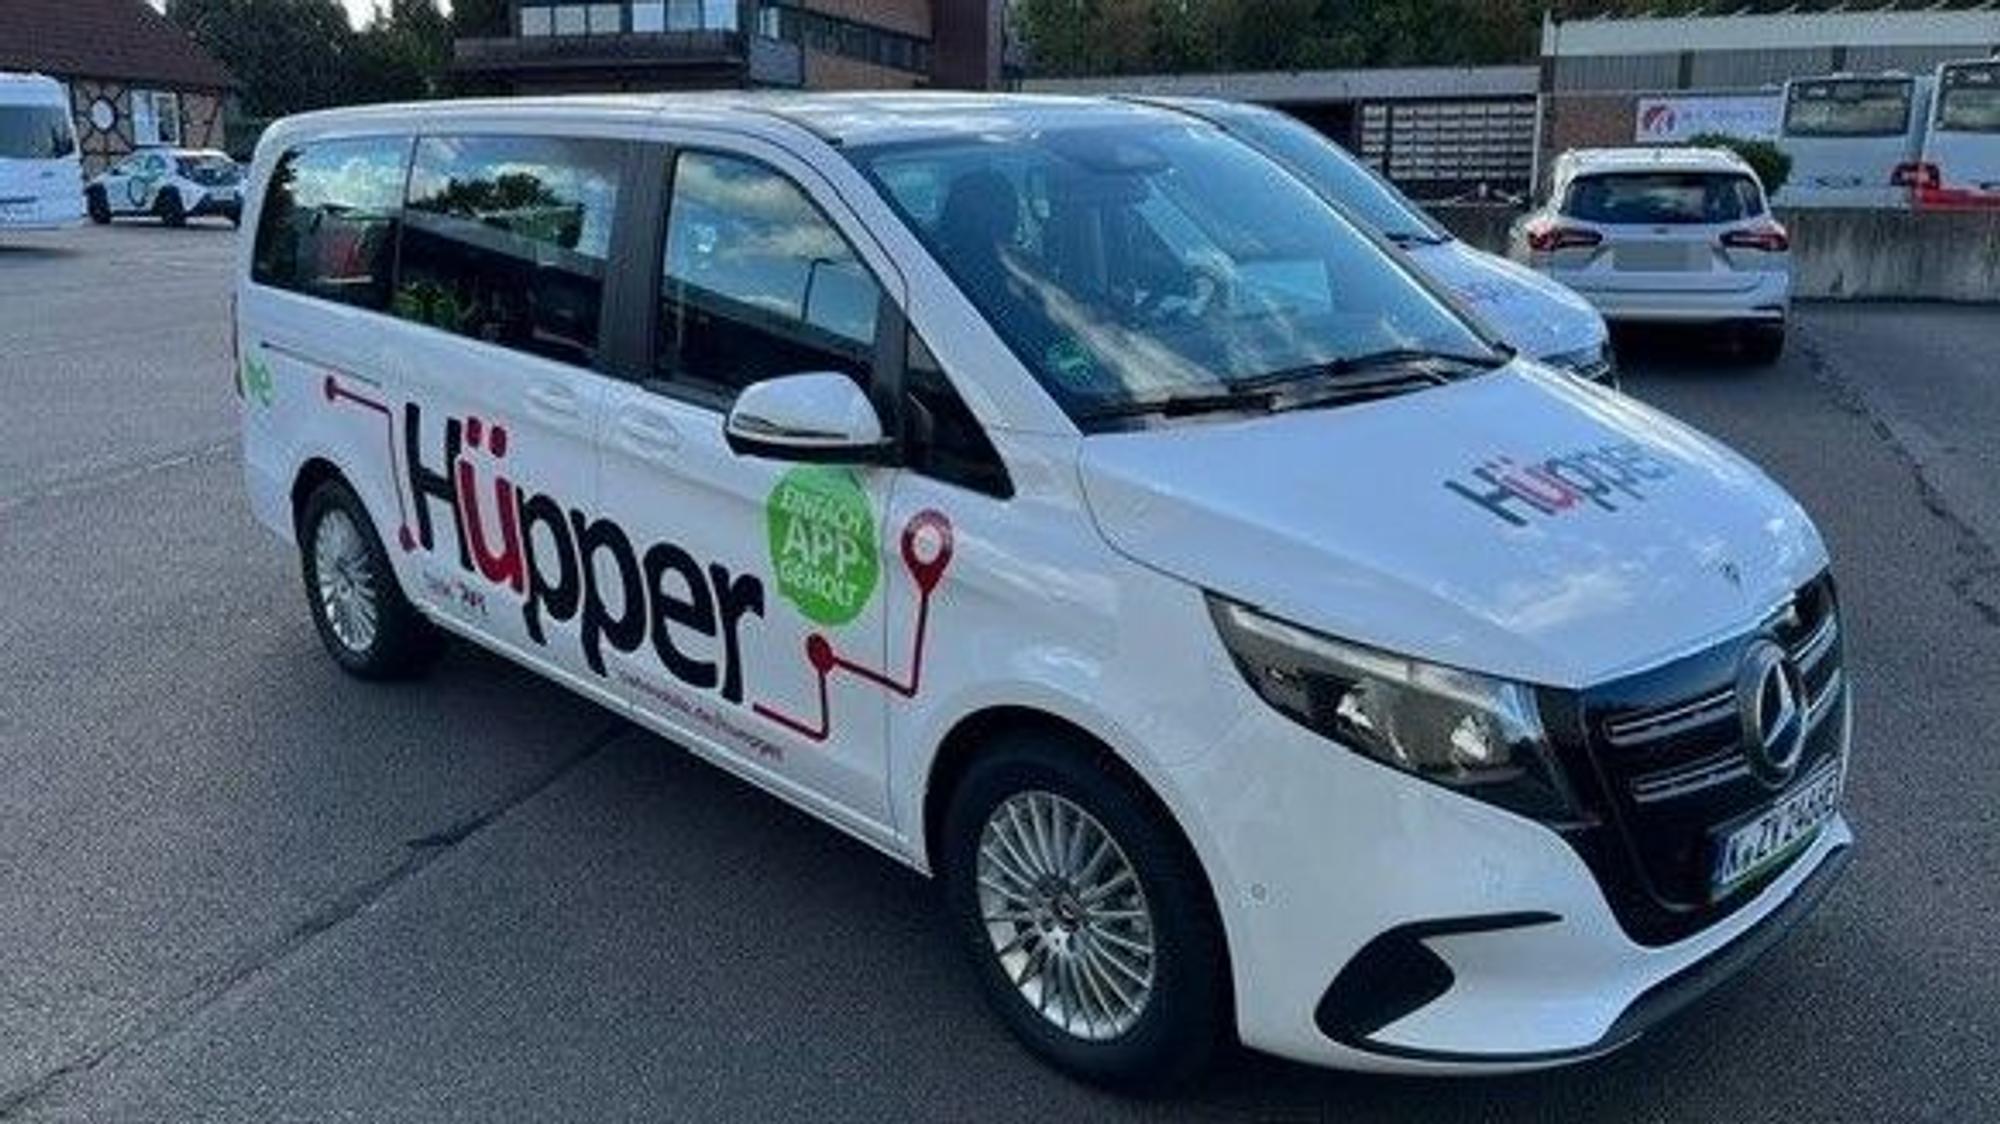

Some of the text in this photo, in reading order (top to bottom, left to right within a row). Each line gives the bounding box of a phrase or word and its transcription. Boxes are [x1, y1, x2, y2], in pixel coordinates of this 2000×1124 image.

[1443, 446, 1676, 527] Hüpper
[406, 402, 765, 704] Hüpper
[782, 513, 861, 578] APP
